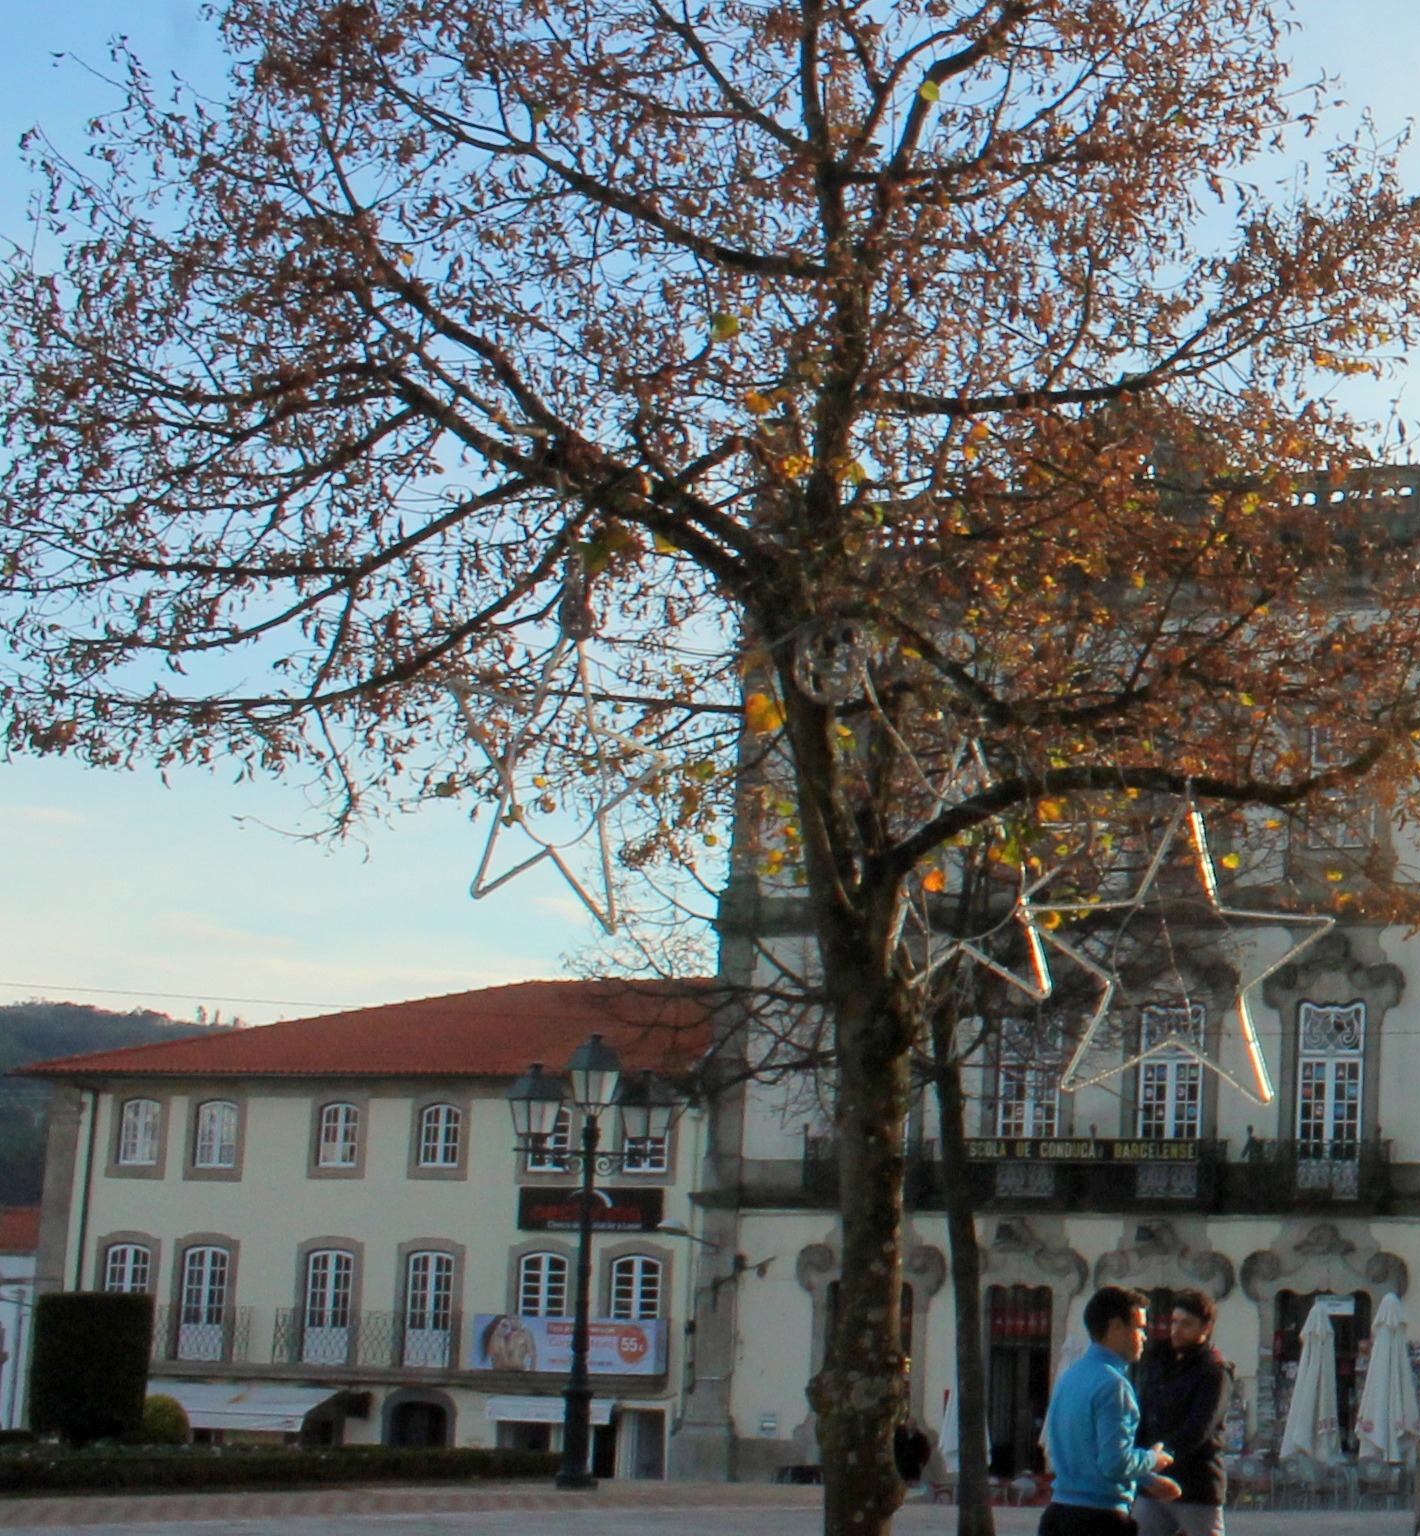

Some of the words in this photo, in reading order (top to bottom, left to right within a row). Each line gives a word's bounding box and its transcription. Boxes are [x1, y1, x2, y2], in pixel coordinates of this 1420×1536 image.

[963, 1141, 1006, 1158] SCOLA
[1015, 1141, 1031, 1158] DE
[1114, 1142, 1195, 1159] BARCELENSE
